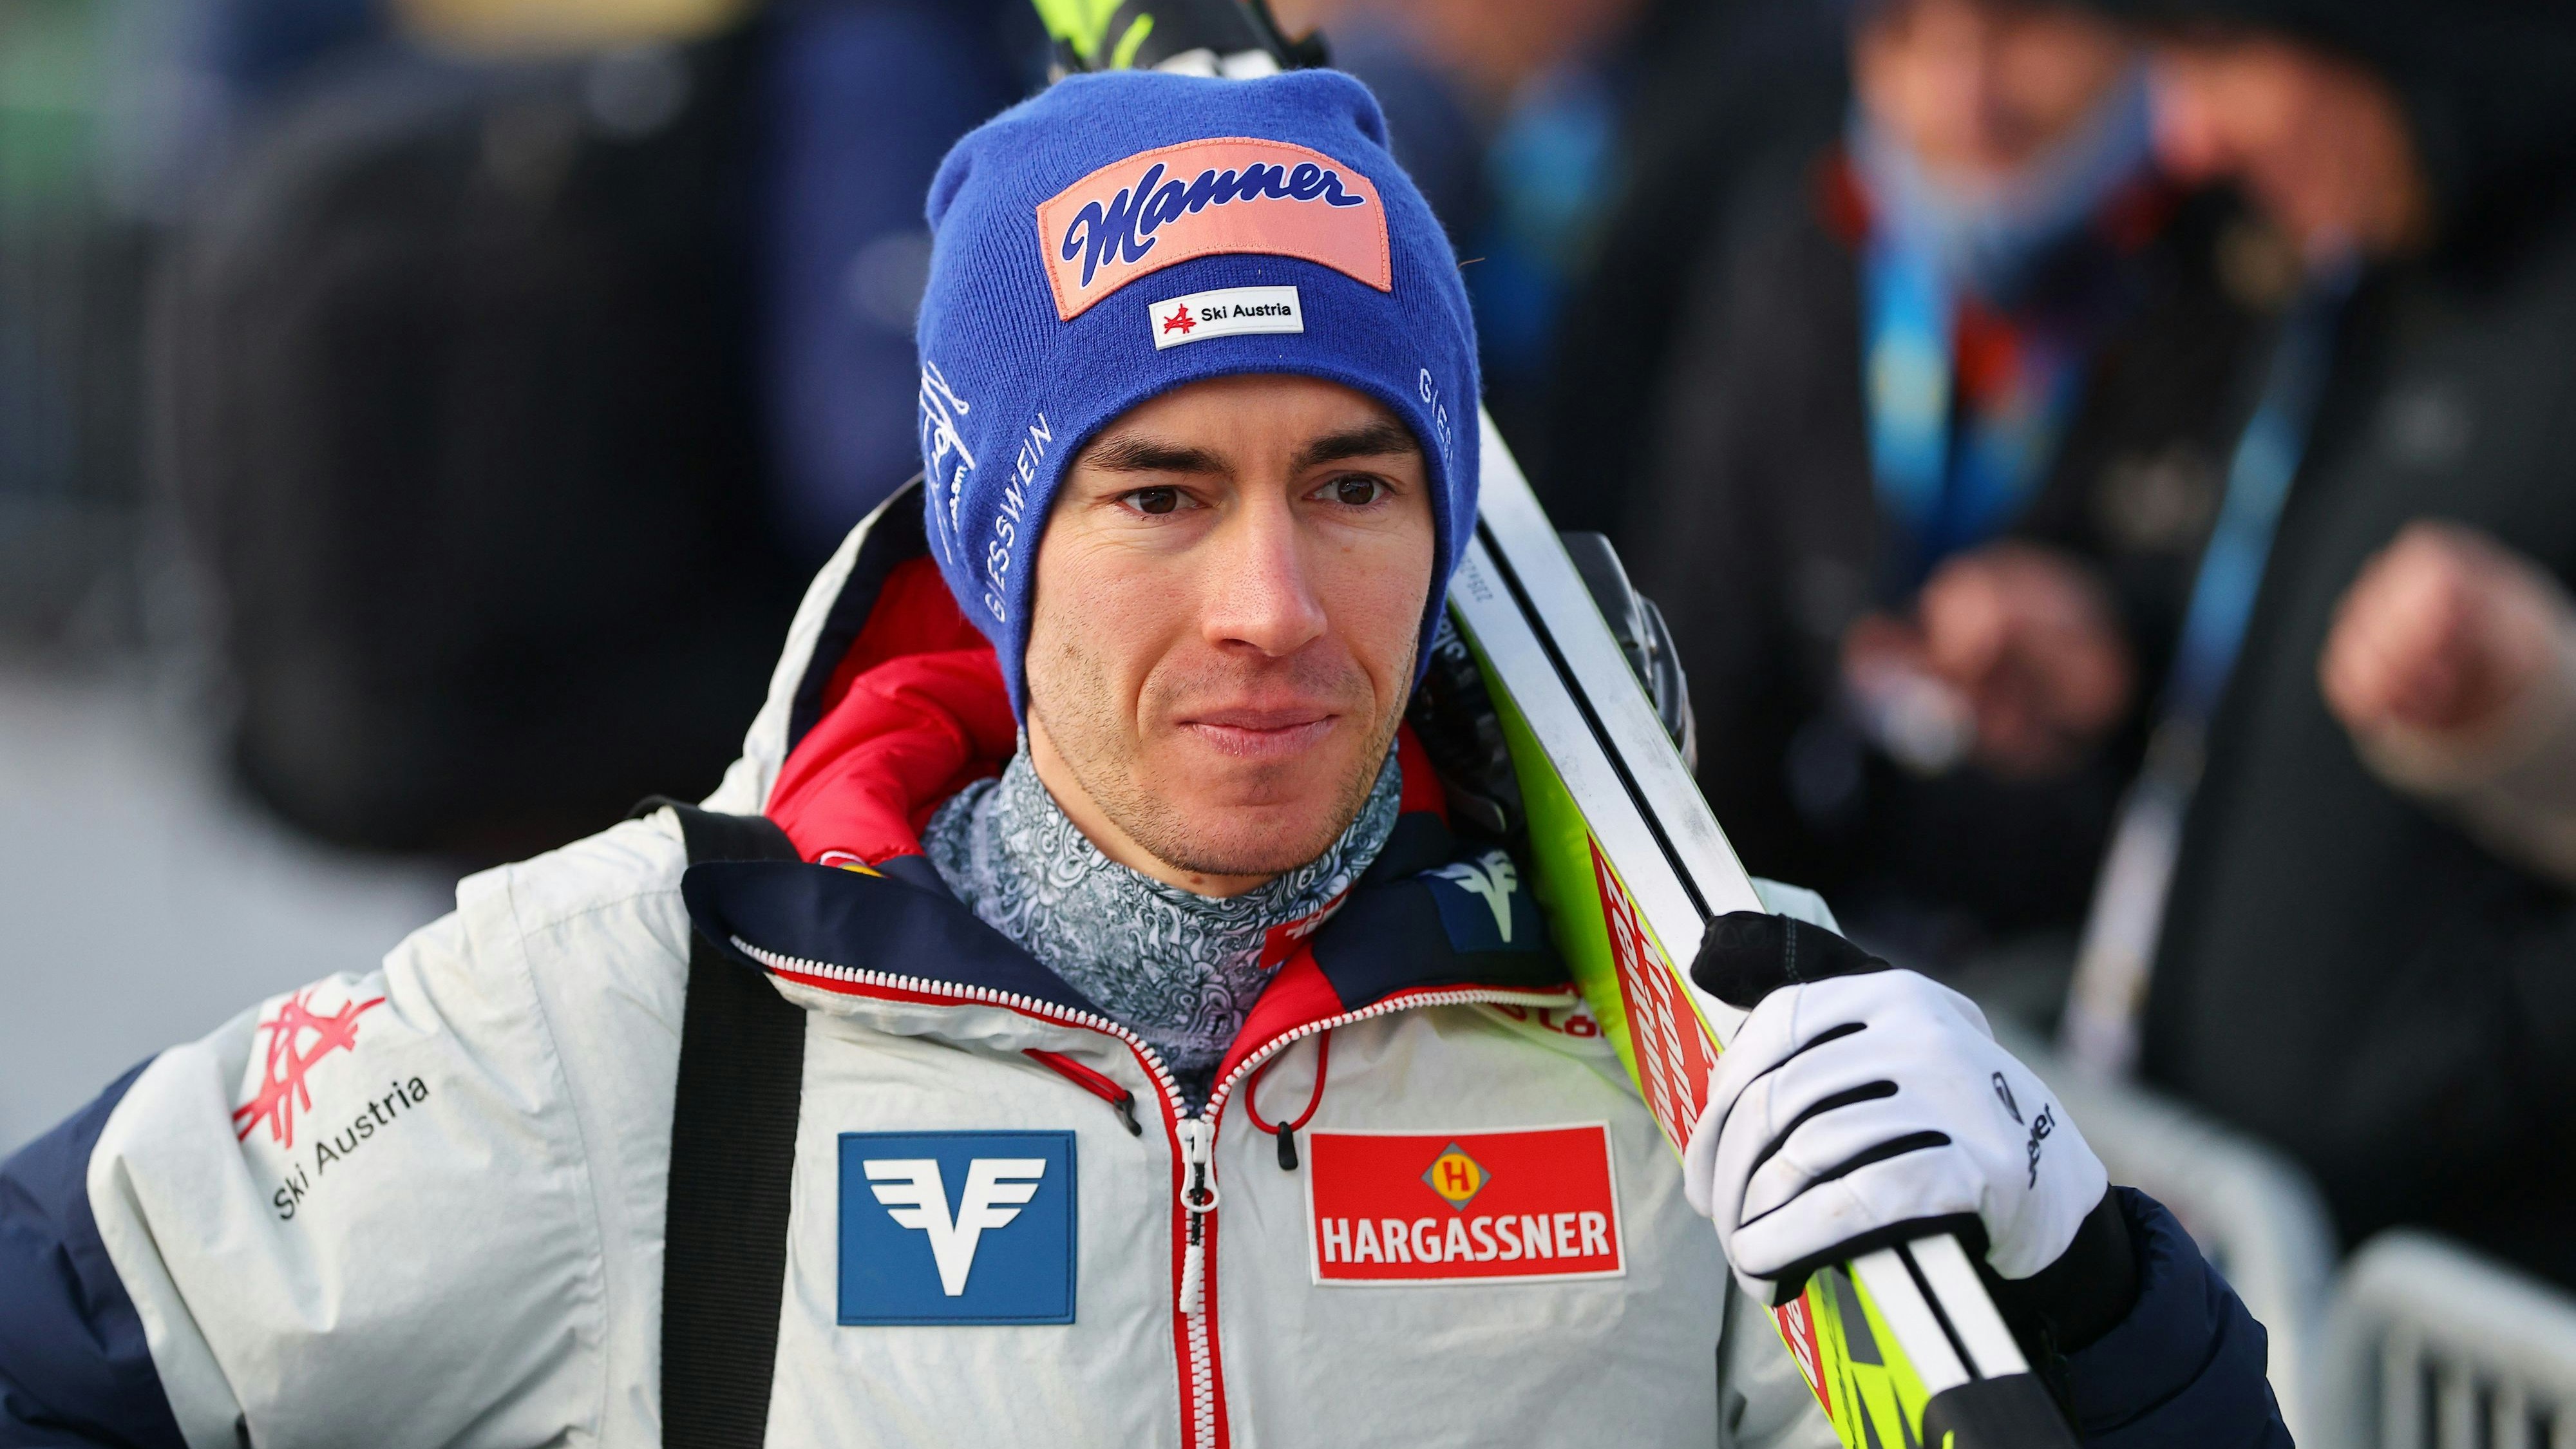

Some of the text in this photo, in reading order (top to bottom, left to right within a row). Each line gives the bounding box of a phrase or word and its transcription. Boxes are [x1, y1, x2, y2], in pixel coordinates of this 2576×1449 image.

[1061, 161, 1365, 289] Manner
[1201, 303, 1292, 321] Ski Austria
[984, 412, 1052, 623] GIESSWEIN
[272, 1076, 430, 1220] Ski Austria
[1443, 1160, 1470, 1192] H
[1321, 1211, 1611, 1264] HARGASSNER
